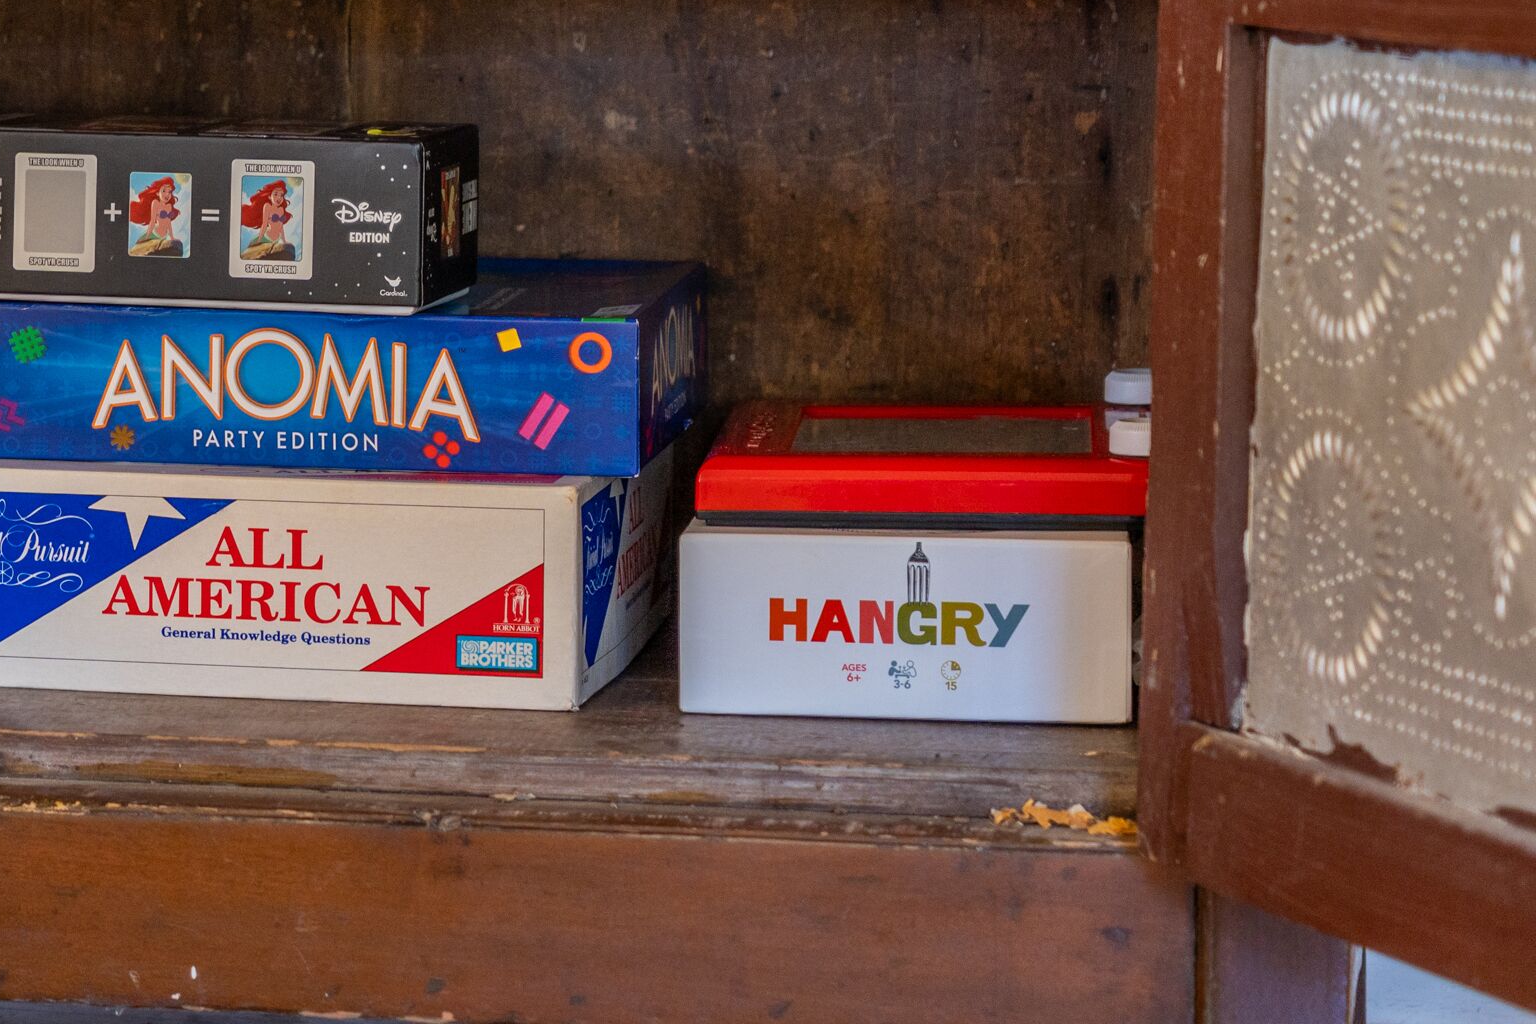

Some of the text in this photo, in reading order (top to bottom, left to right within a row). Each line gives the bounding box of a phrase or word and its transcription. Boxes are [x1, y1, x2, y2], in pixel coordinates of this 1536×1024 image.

[331, 198, 402, 232] Disney
[349, 232, 390, 243] EDITION
[379, 288, 406, 297] Cardinal
[92, 327, 481, 443] ANOMIA
[192, 429, 380, 453] PARTY EDITION
[4, 525, 91, 564] Pursuit
[206, 526, 324, 570] ALL
[102, 575, 430, 627] AMERICAN
[492, 624, 540, 633] HORN ABBOT
[768, 597, 1031, 648] HANGRY
[161, 626, 371, 646] General Knowledge Questions
[479, 640, 533, 655] PARKER
[460, 653, 533, 668] BROTHERS
[841, 663, 867, 672] AGES
[846, 673, 862, 682] 6+
[893, 680, 912, 690] 3-6
[945, 681, 958, 691] 15
